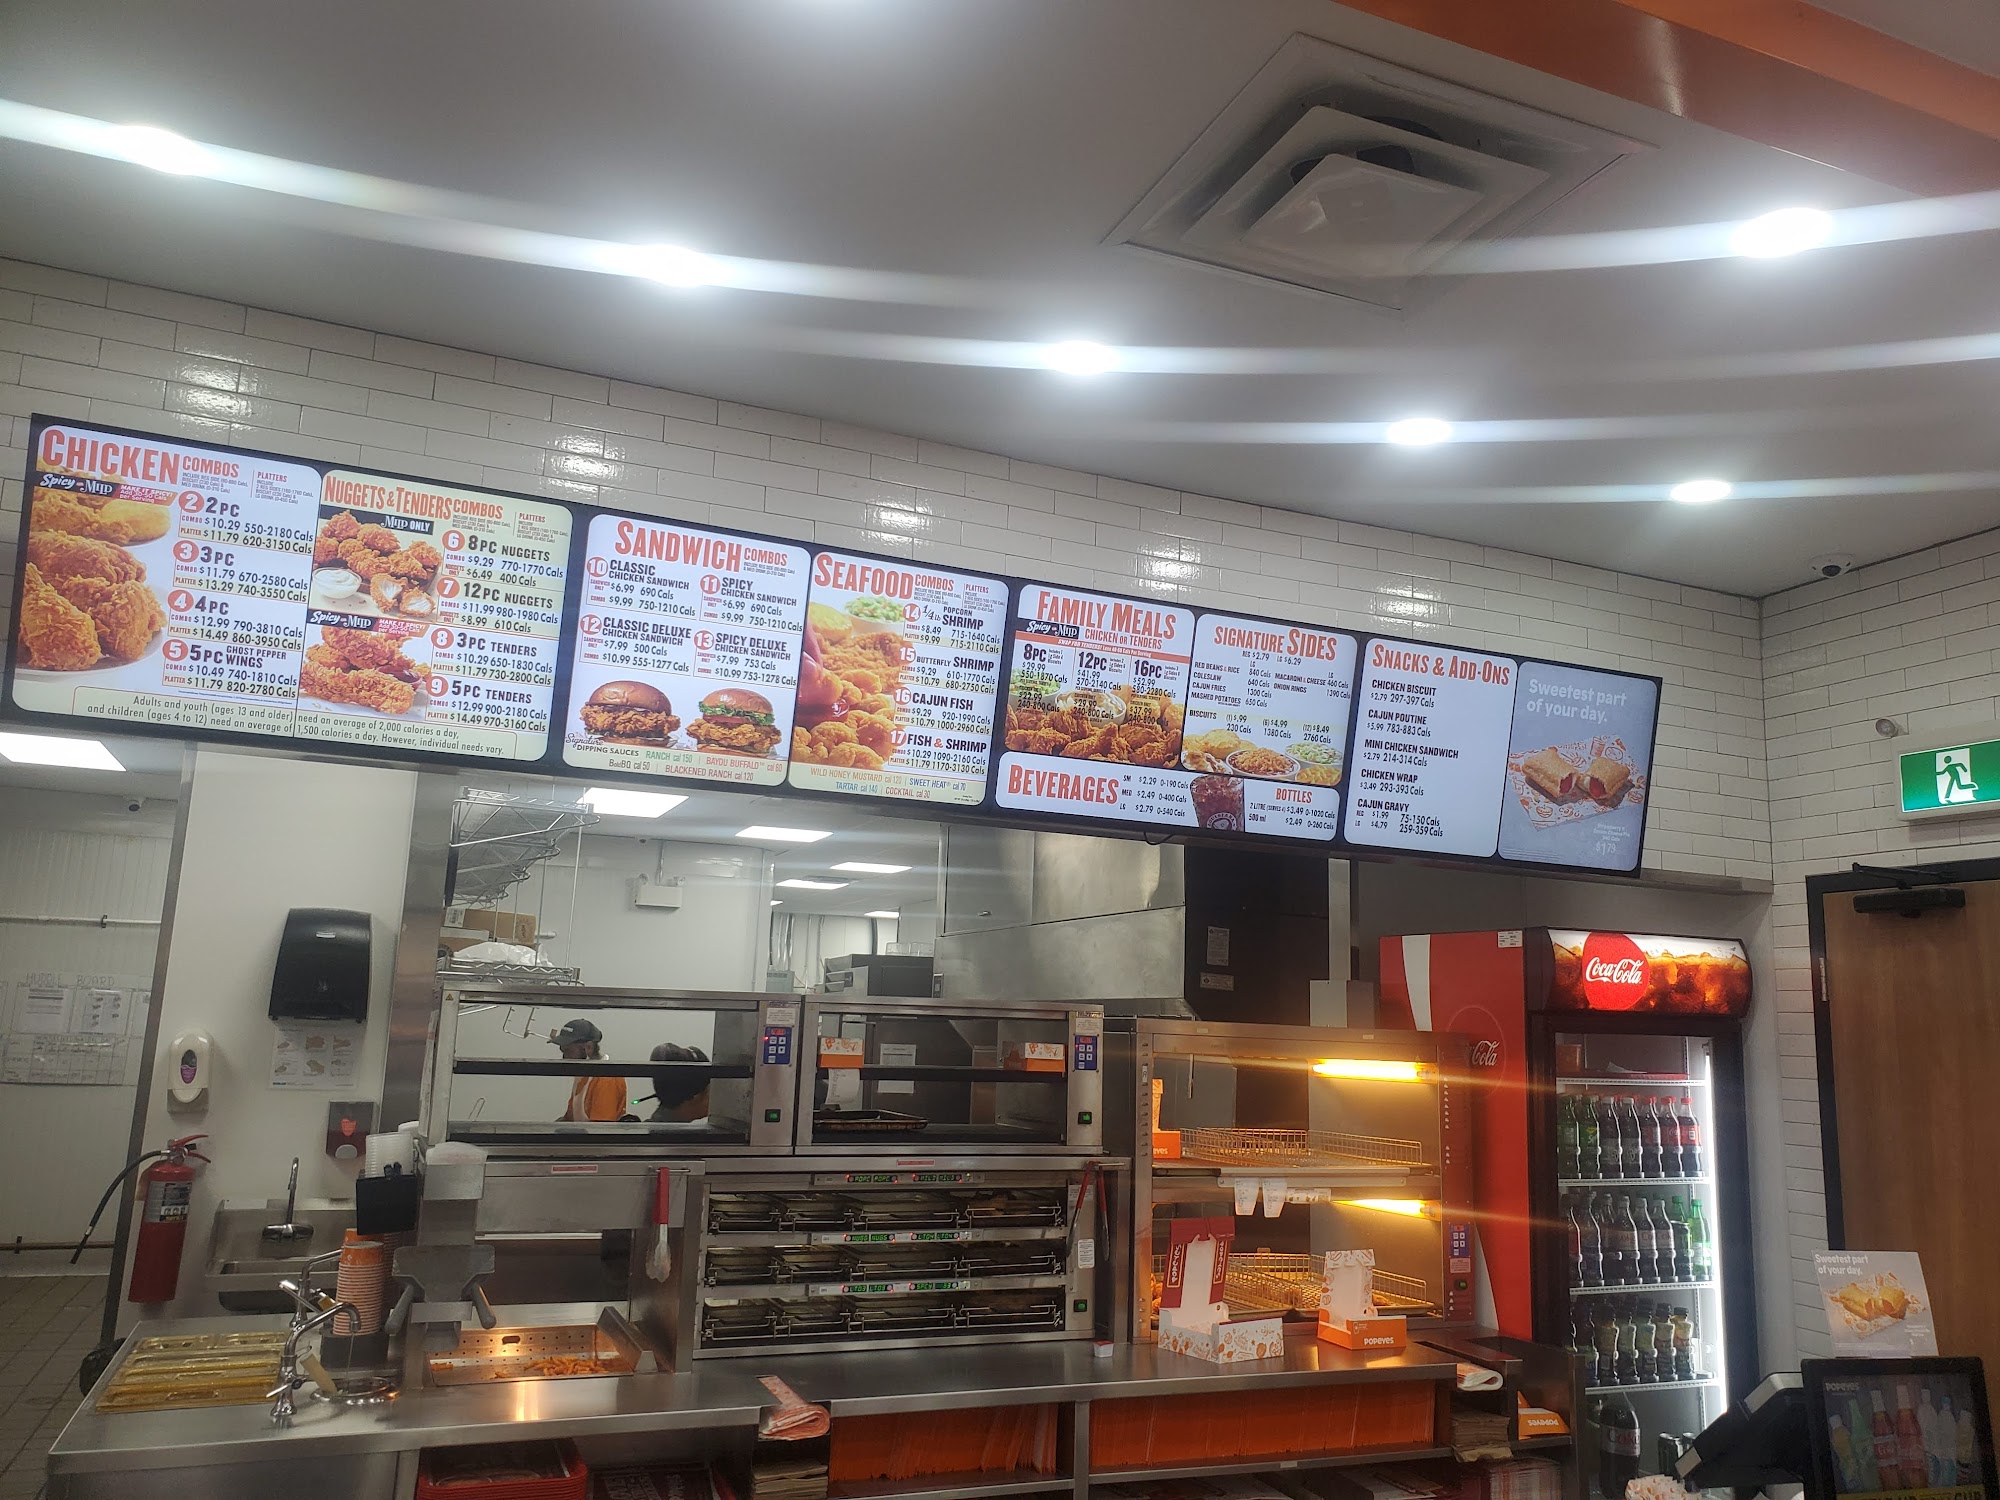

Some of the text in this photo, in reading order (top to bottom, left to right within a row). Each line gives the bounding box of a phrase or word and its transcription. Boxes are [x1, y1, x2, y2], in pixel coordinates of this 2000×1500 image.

[41, 427, 180, 485] CHICKEN
[182, 455, 239, 478] COMBOS
[40, 473, 75, 491] Spicy
[257, 471, 287, 482] PLATTERS
[185, 494, 197, 509] 2
[325, 475, 386, 510] NUGGETS
[386, 490, 395, 506] &
[394, 488, 452, 520] TENDERS
[453, 499, 503, 519] COMBOS
[181, 515, 313, 542] COMBO $10.29 550-2180 Cals
[409, 520, 430, 533] ONLY
[180, 527, 312, 554] PLATTER $11.79 620-3150 Cals
[448, 534, 459, 548] 6
[501, 545, 550, 562] NUGGETS
[614, 519, 742, 572] SANDWICH
[744, 547, 787, 566] COMBOS
[468, 555, 563, 578] $9.29 770-1770 Cals
[589, 559, 655, 576] 10 CLASSIC
[466, 567, 536, 587] $6.49 400 Cals
[608, 570, 689, 590] CHICKEN SANDWICH
[814, 552, 914, 600] SEAFOOD
[914, 574, 954, 591] COMBOS
[610, 582, 673, 600] $6.99 690 Cals
[608, 595, 695, 616] $9.99 750-1210 Cals
[1037, 590, 1107, 630] FAMILY
[1110, 602, 1176, 640] MEALS
[436, 632, 448, 645] 8
[490, 641, 536, 656] TENDERS
[697, 632, 787, 652] 13 SPICY DELUXE
[1084, 628, 1118, 643] CHICKEN
[1129, 635, 1162, 649] TENDERS
[1214, 625, 1337, 662] SIGNATURE SIDES
[168, 643, 180, 657] 5
[226, 645, 286, 660] GHOST PEPPER
[1023, 643, 1046, 662] 8PC
[1252, 651, 1301, 666] $2.79 $6.29
[225, 653, 262, 668] WINGS
[1022, 661, 1045, 671] $29.99
[1077, 651, 1107, 670] 12PC
[1133, 659, 1162, 678] 16PC
[1372, 643, 1510, 686] SNACKS & ADD-ONS
[1077, 669, 1100, 679] $41.99
[1133, 676, 1155, 686] $52.99
[1193, 671, 1221, 681] COLESLAW
[1192, 681, 1226, 692] CAJUN FRIES
[1371, 679, 1436, 696] CHICKEN BISCUIT
[1528, 678, 1626, 709] Sweetest part
[894, 689, 973, 710] 16 CAJUN FISH
[1370, 692, 1434, 708] $2.79 297-397 Cals
[133, 695, 459, 739] Adults and youth (ages 13 and older) need an average of 2,000 calories a day,
[911, 707, 990, 725] $9.29 920-1990 Cals
[1189, 709, 1216, 720] BISCUITS
[1368, 708, 1426, 725] CAJUN POUTINE
[1526, 697, 1608, 725] of your day.
[577, 744, 638, 756] DIPPING SAUCES
[890, 730, 986, 753] 17 FISH & SHRIMP
[1364, 738, 1458, 759] MINI CHICKEN SANDWICH
[645, 750, 692, 763] RANCH cal 150
[665, 764, 753, 781] BLACKENED RANCH cal 120
[810, 767, 882, 782] WILD HONEY MUSTARD
[1008, 764, 1120, 804] BEVERAGES
[1138, 776, 1156, 786] $2.29
[1160, 778, 1176, 788] 0-190
[1177, 780, 1188, 789] Cals
[1276, 787, 1312, 803] BOTTLES
[1357, 798, 1409, 812] CAJUN GRAVY
[1586, 957, 1644, 984] Coca-Cola
[1815, 1254, 1868, 1265] Sweetest part
[1818, 1265, 1863, 1276] of your day.
